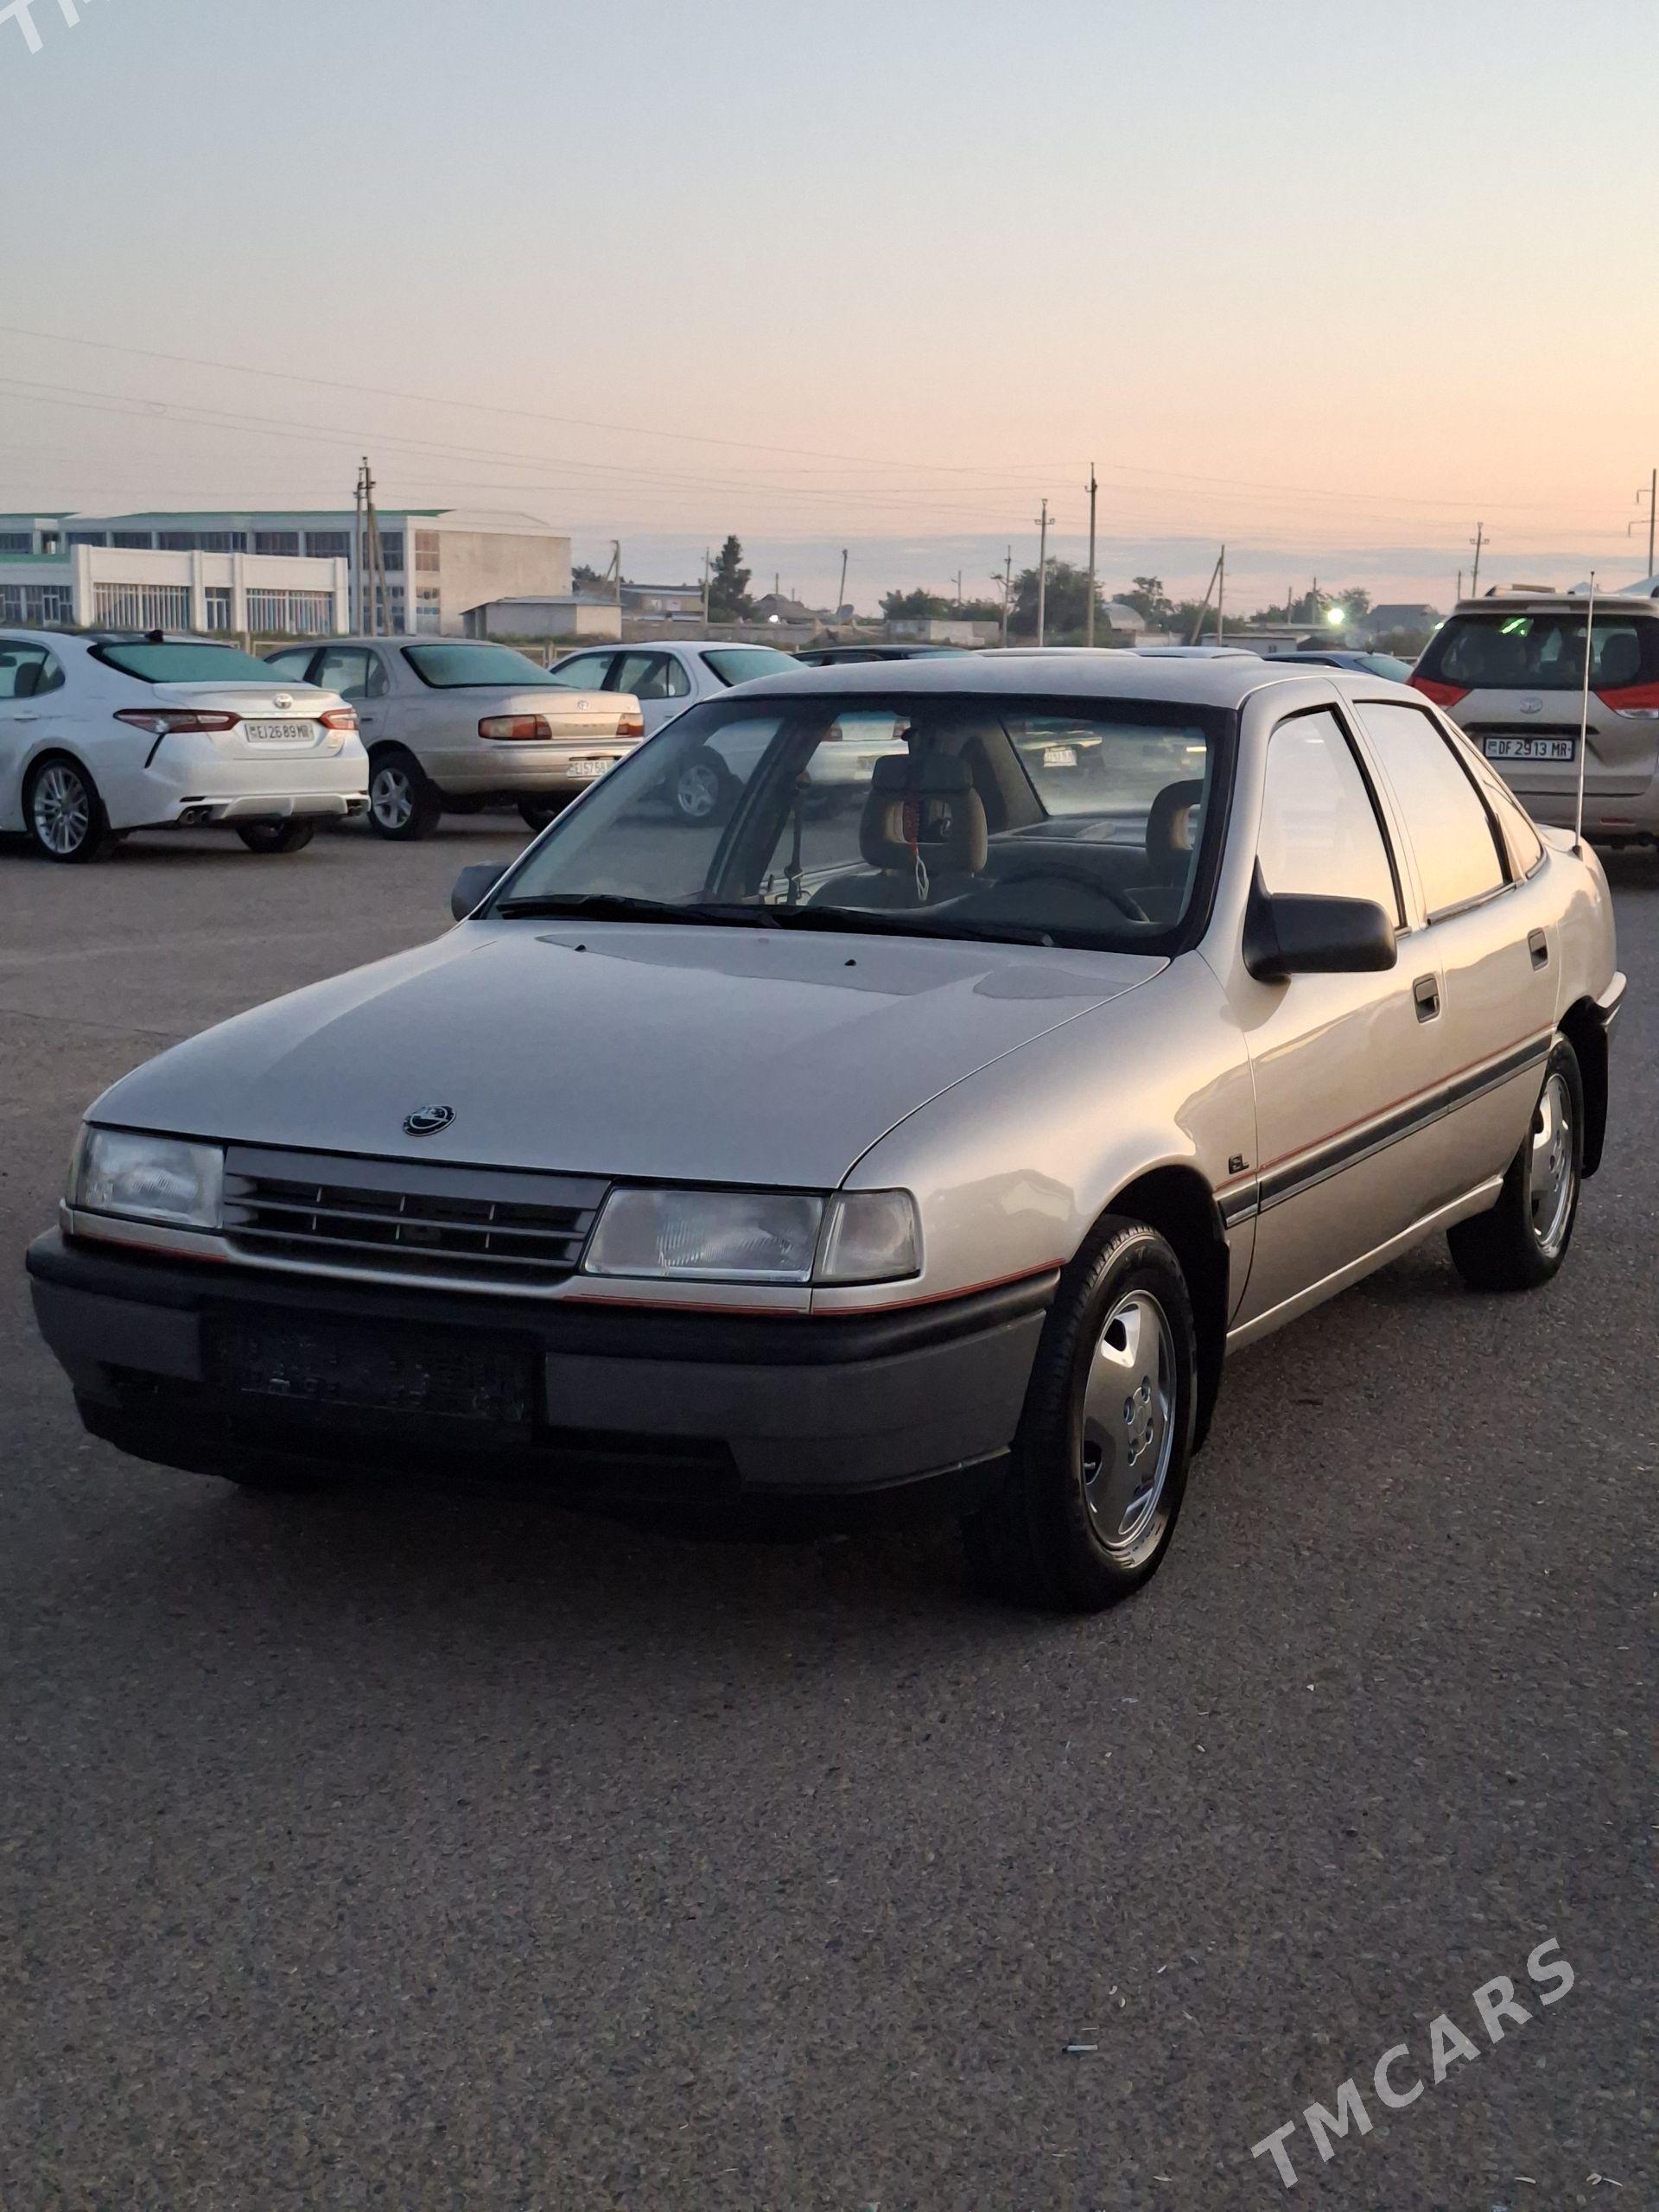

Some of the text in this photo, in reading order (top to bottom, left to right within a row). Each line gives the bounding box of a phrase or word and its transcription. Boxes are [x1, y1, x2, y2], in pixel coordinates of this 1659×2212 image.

[1498, 741, 1567, 757] DF 2913 MR
